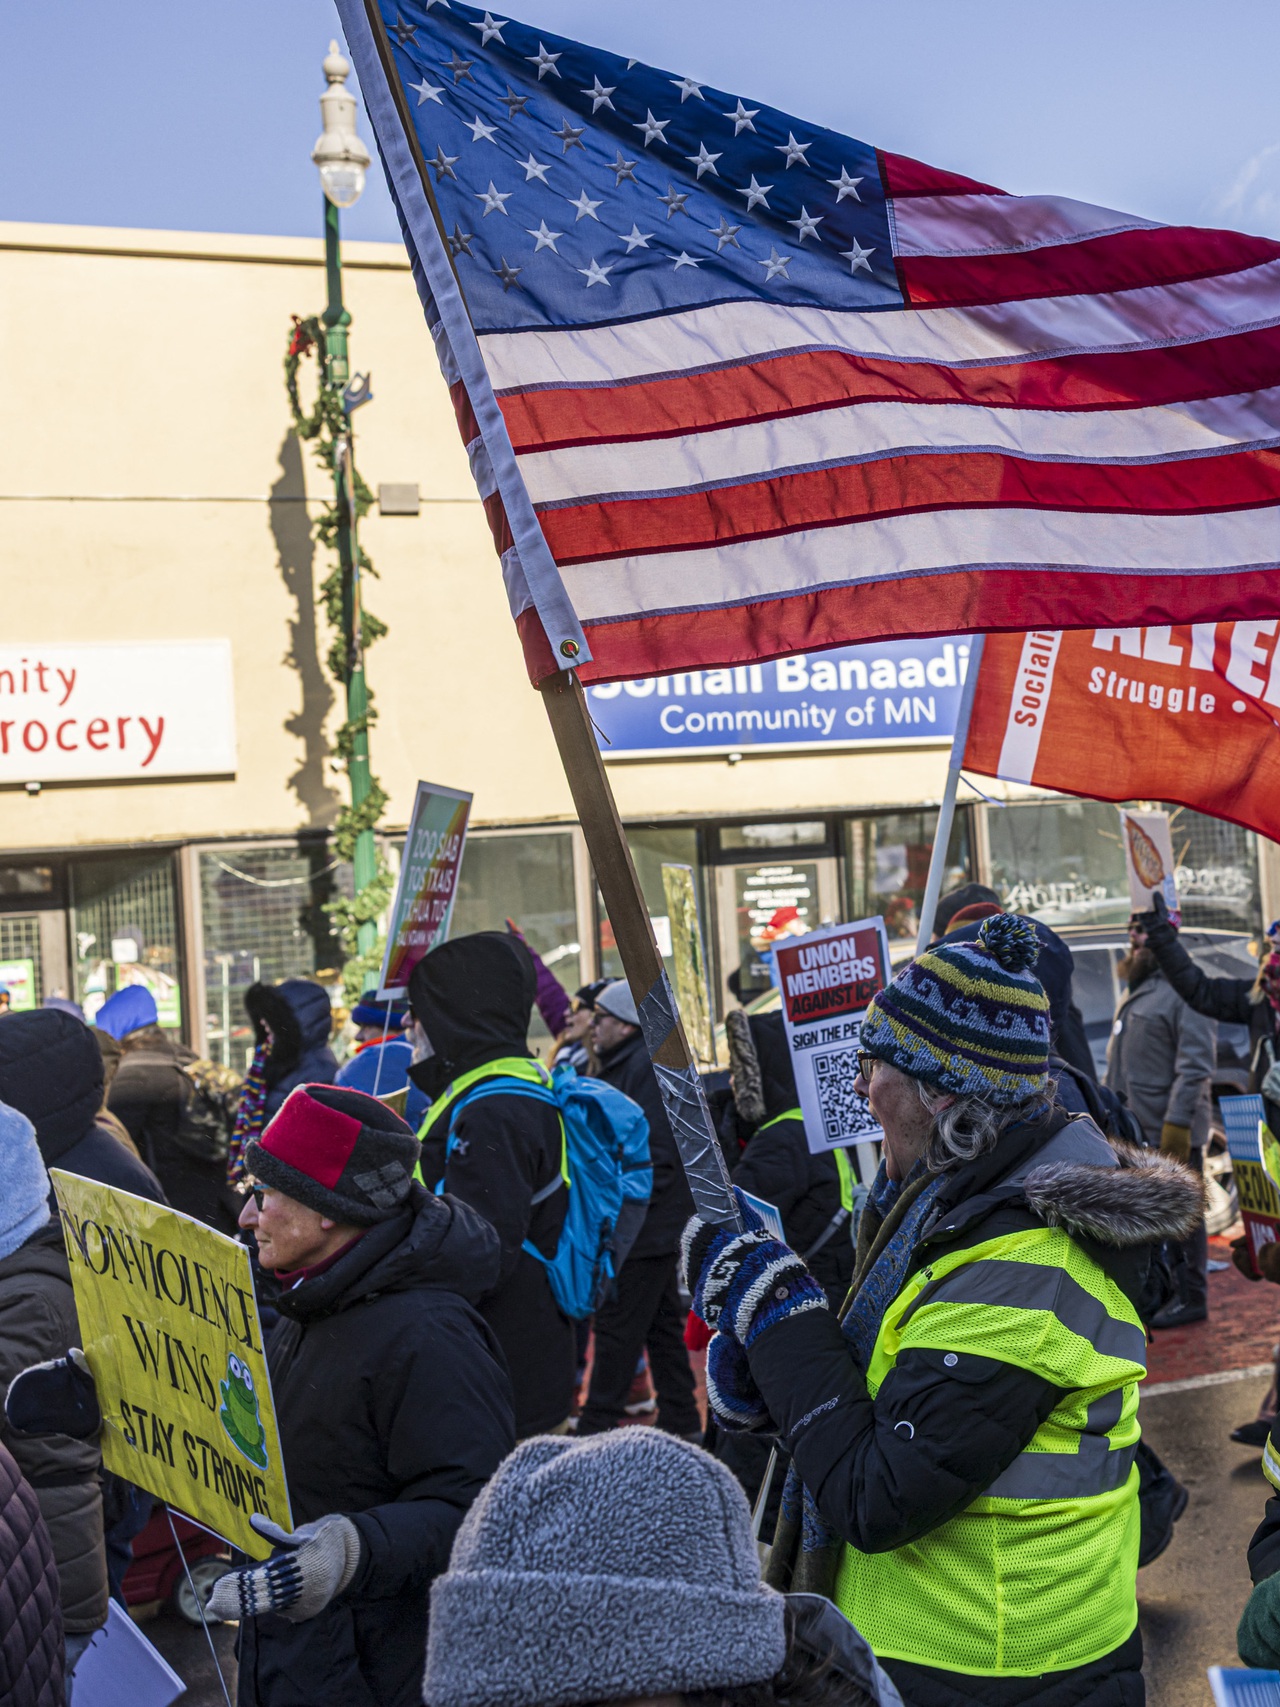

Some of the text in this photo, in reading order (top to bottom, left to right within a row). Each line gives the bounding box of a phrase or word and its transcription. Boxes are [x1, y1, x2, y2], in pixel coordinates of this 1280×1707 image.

[1014, 630, 1056, 728] Sociali
[1088, 666, 1216, 713] Struggle
[659, 696, 937, 735] Community of MN
[798, 937, 857, 971] UNION
[786, 956, 877, 997] MEMBERS
[791, 979, 880, 1017] AGAINST ICE
[792, 1030, 819, 1049] SIGN
[820, 1025, 842, 1041] THE
[60, 1208, 263, 1355] NON-VIOLENCE
[121, 1314, 217, 1412] WINS
[119, 1398, 273, 1515] STAY STRONG
